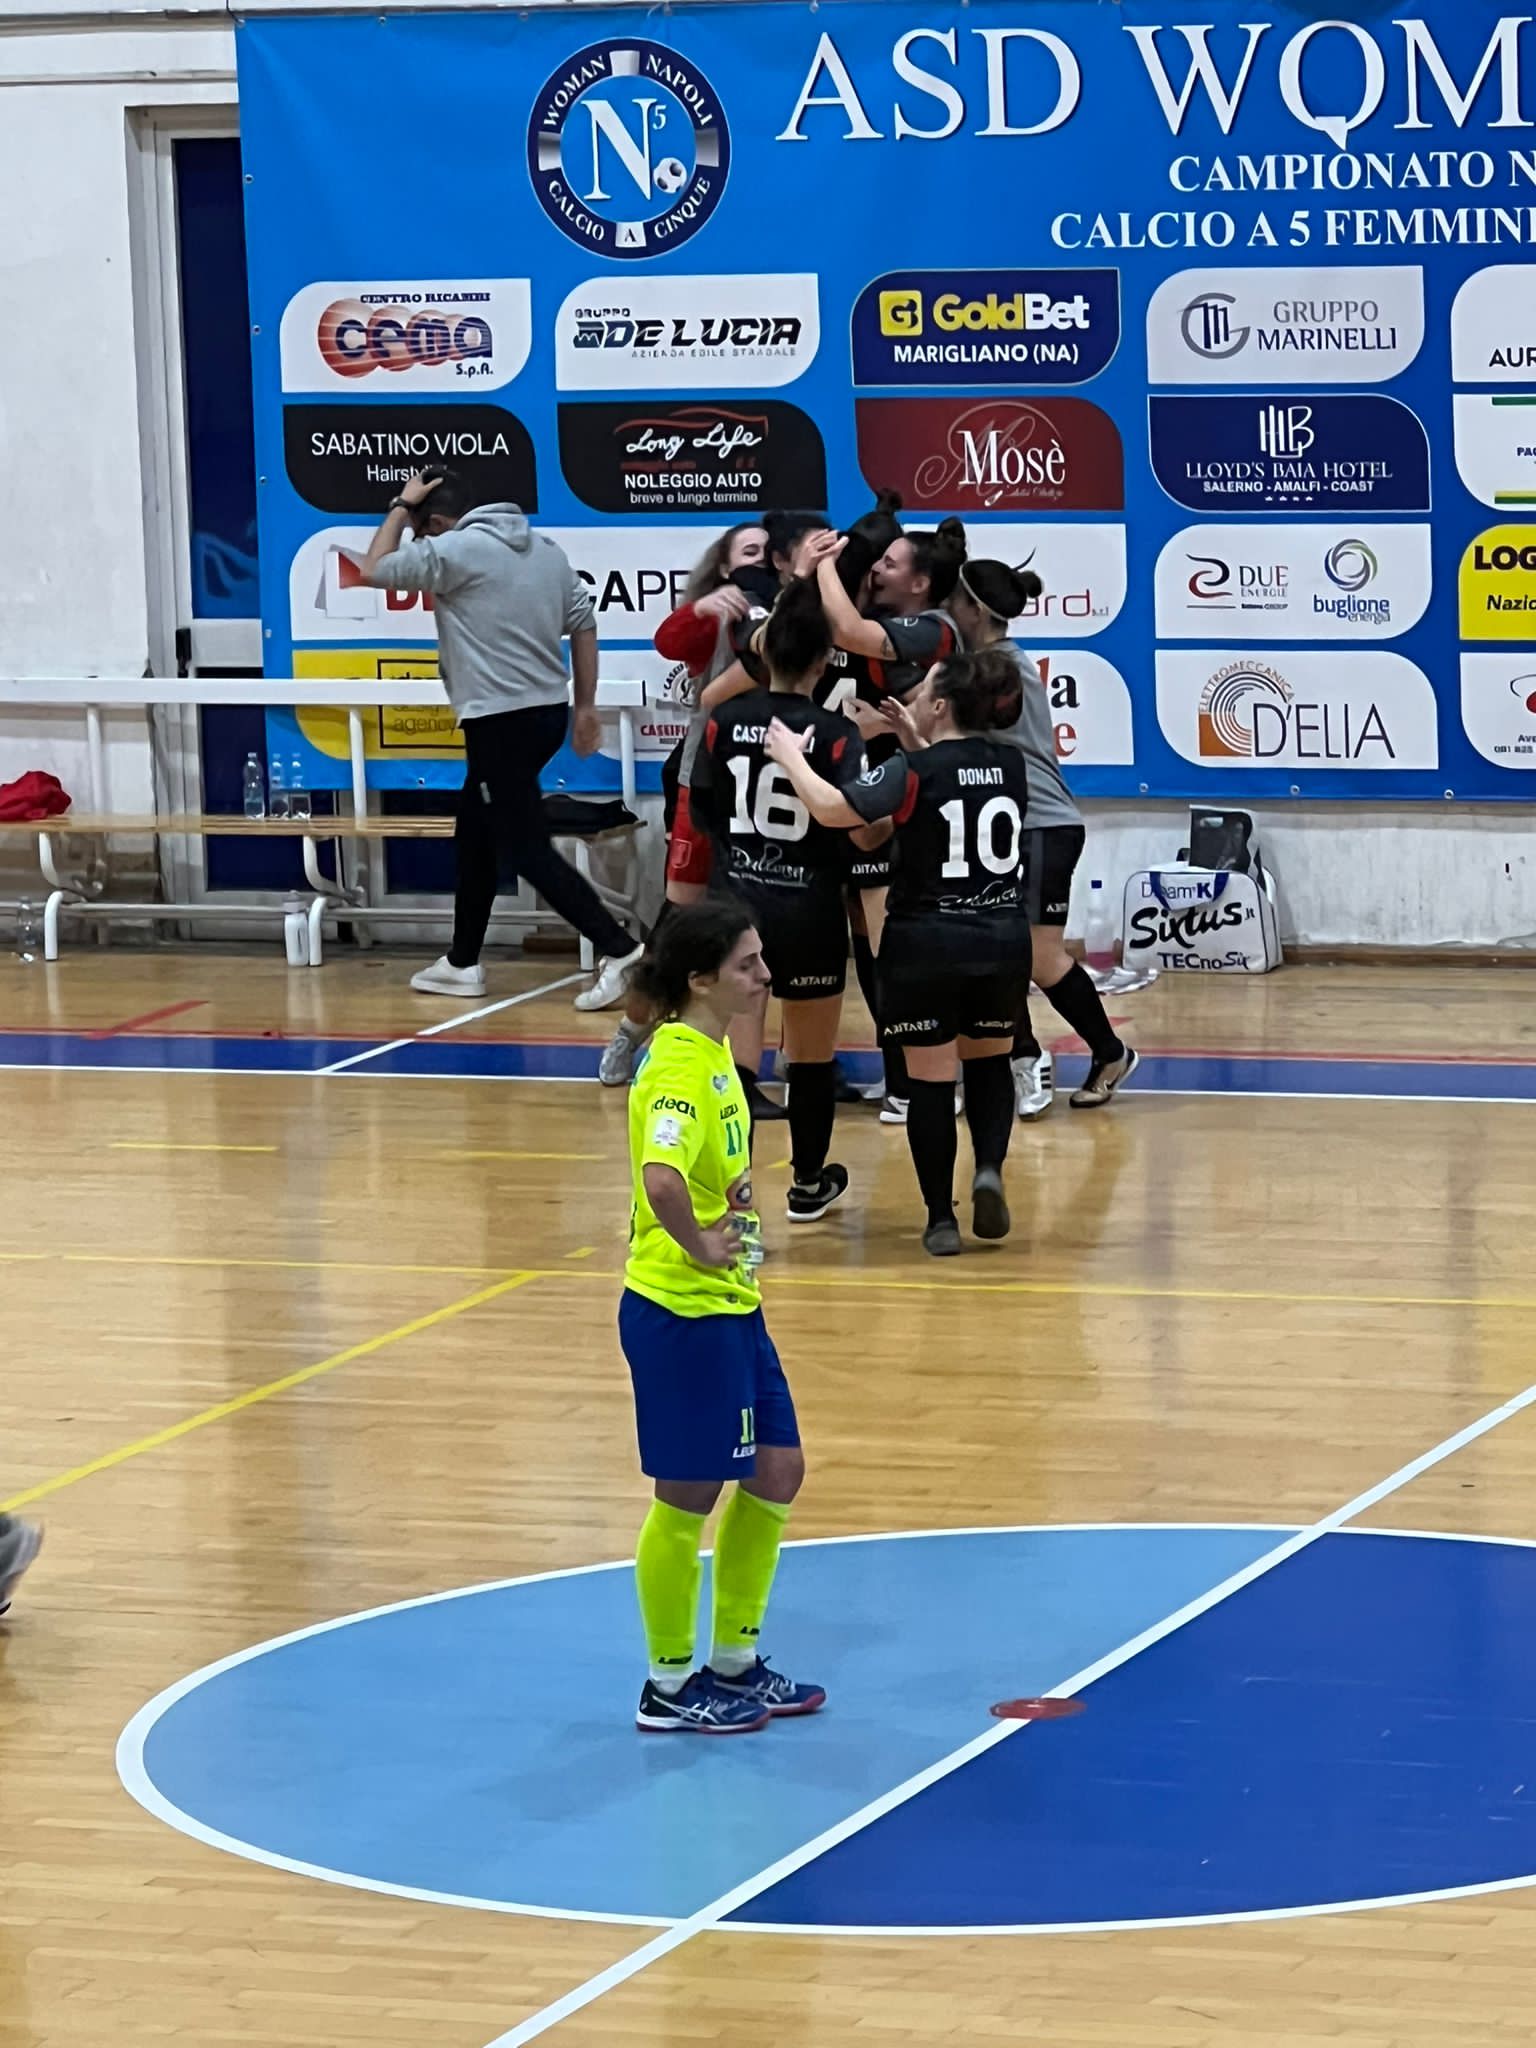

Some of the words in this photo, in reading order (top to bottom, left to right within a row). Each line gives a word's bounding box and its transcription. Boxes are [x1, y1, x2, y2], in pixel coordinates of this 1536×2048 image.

[543, 55, 606, 126] WOMAN
[646, 54, 713, 126] NAPOLI
[775, 27, 1081, 141] ASD
[580, 98, 658, 201] N
[1169, 151, 1495, 192] CAMPIONATO
[549, 180, 605, 241] CALCIO
[624, 228, 637, 243] A
[654, 176, 711, 239] CINQUE
[1050, 211, 1235, 249] CALCIO
[1247, 211, 1279, 246] A
[1289, 210, 1311, 246] 5
[360, 294, 423, 304] CENTRO
[932, 293, 1090, 330] GoldBet
[1273, 300, 1379, 323] GRUPPO
[574, 307, 631, 319] GRUPPO
[603, 320, 665, 348] DE
[670, 317, 802, 347] LUCIA
[1257, 327, 1397, 351] MARINELLI
[894, 345, 1028, 363] MARIGLIANO
[1033, 343, 1079, 365] (NA)
[311, 432, 430, 456] SABATINO
[434, 432, 510, 456] VIOLA
[626, 428, 685, 461] Long
[956, 430, 1066, 485] Mosè
[624, 473, 712, 489] NOLEGGIO
[716, 472, 763, 488] AUTO
[1186, 461, 1266, 478] LLOYD'S
[1272, 462, 1316, 478] BAIA
[1323, 461, 1393, 478] HOTEL
[629, 491, 664, 504] breve
[677, 491, 711, 507] lungo
[713, 490, 759, 503] termine
[1203, 480, 1264, 492] SALERNO
[1273, 481, 1320, 492] AMALFI
[1330, 480, 1375, 492] COAST
[1239, 565, 1289, 587] DUE
[1313, 594, 1390, 618] buglione
[1252, 701, 1397, 760] D'ELIA
[957, 767, 1004, 787] DONATI
[726, 755, 811, 843] 16
[938, 796, 1023, 879] 10
